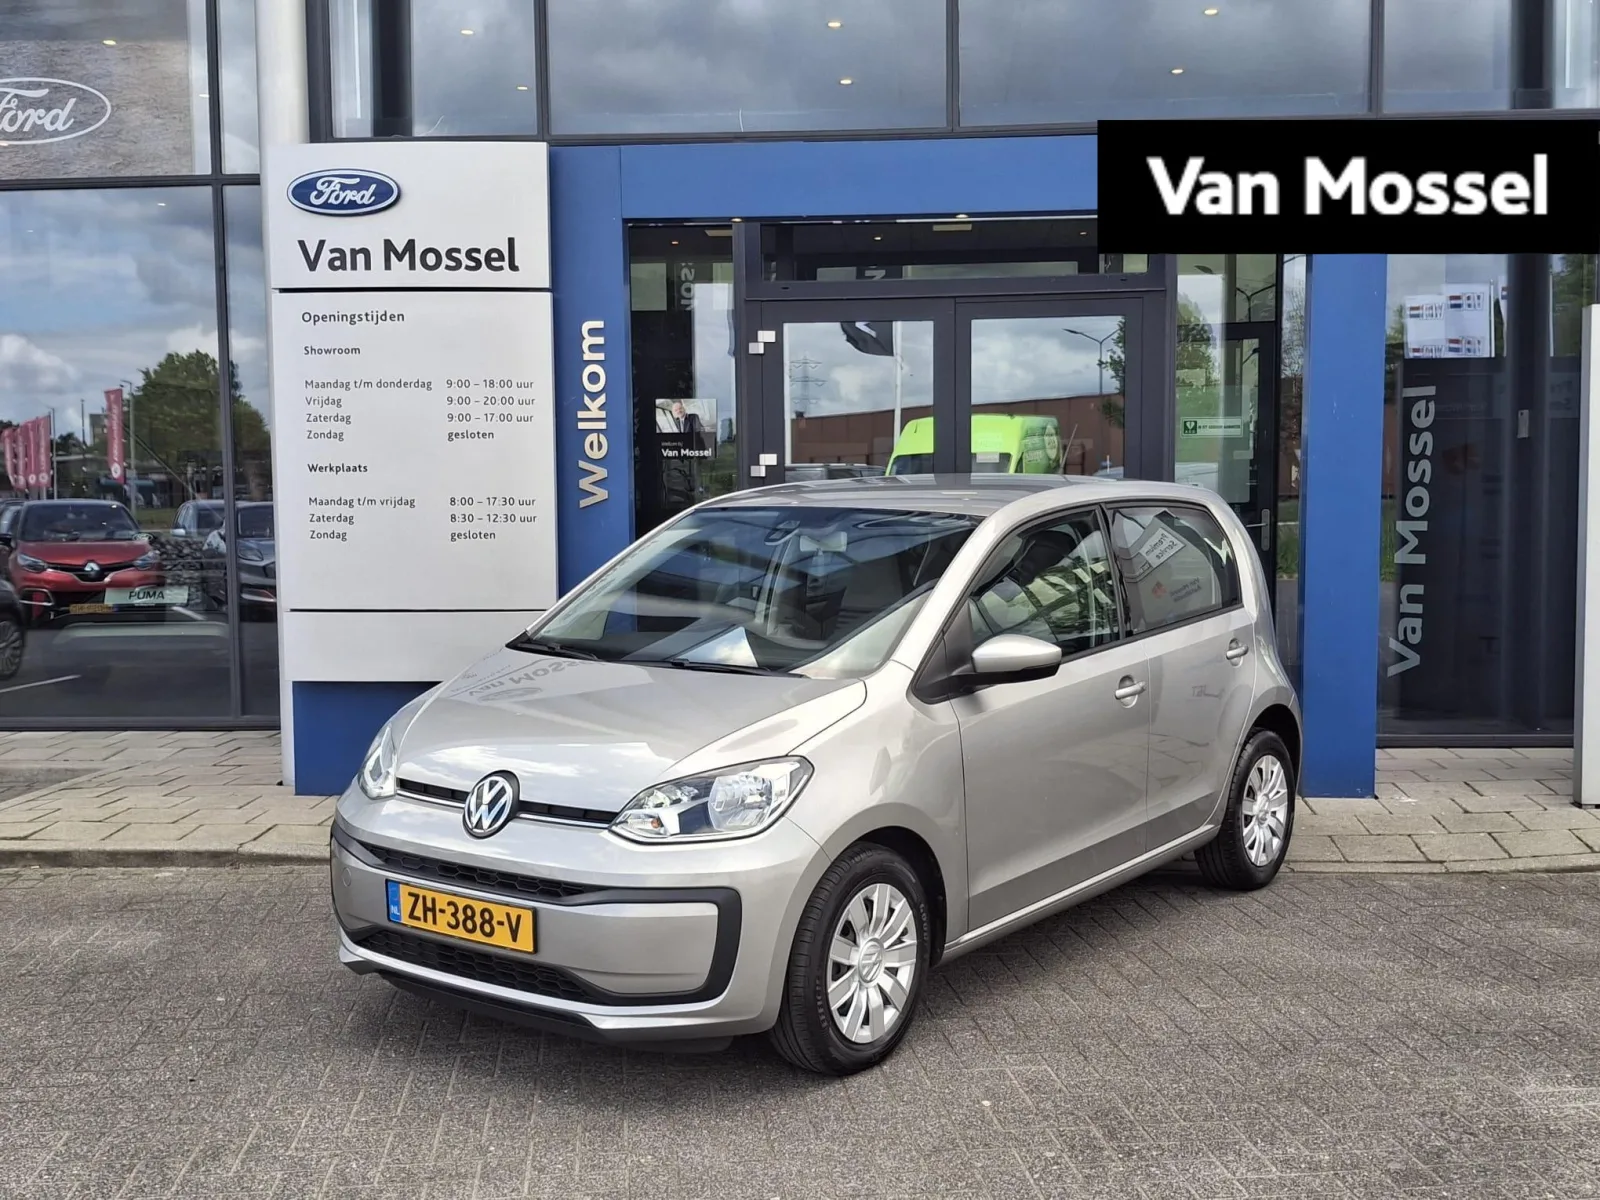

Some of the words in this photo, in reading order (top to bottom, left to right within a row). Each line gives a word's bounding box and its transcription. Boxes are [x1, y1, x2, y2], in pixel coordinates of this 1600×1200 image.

[309, 174, 378, 207] Ford
[298, 240, 371, 272] Van
[383, 237, 520, 272] Mossel
[301, 310, 405, 326] Openingstijden
[303, 345, 361, 355] Showroom
[304, 379, 351, 391] Maandag
[353, 379, 373, 389] t/m
[376, 378, 433, 391] donderdag
[446, 378, 471, 389] 9:00
[483, 378, 513, 389] 18:00
[516, 381, 534, 389] uur
[305, 396, 343, 408] Vrijdag
[446, 395, 472, 406] 9:00
[483, 395, 515, 406] 20:00
[518, 398, 536, 406] uur
[306, 413, 352, 425] Zaterdag
[447, 412, 472, 423] 9:00
[484, 412, 513, 423] 17:00
[516, 415, 534, 423] uur
[577, 320, 609, 508] Welkom
[306, 429, 345, 442] Zondag
[447, 430, 495, 442] gesloten
[661, 448, 679, 457] Van
[680, 447, 712, 457] Mossel
[307, 463, 368, 476] Werkplaats
[1393, 385, 1437, 565] Mossel
[308, 496, 355, 508] Maandag
[357, 496, 377, 507] t/m
[379, 496, 416, 508] vrijdag
[449, 496, 474, 507] 8:00
[486, 496, 516, 507] 17:30
[518, 499, 536, 507] uur
[309, 513, 355, 525] Zaterdag
[450, 513, 475, 524] 8:30
[487, 513, 517, 524] 12:30
[520, 515, 537, 523] uur
[310, 530, 348, 542] Zondag
[450, 530, 496, 542] gesloten
[128, 590, 165, 600] PUMA
[1387, 584, 1425, 678] Van
[391, 905, 400, 915] NL
[407, 891, 522, 943] ZH-388-V
